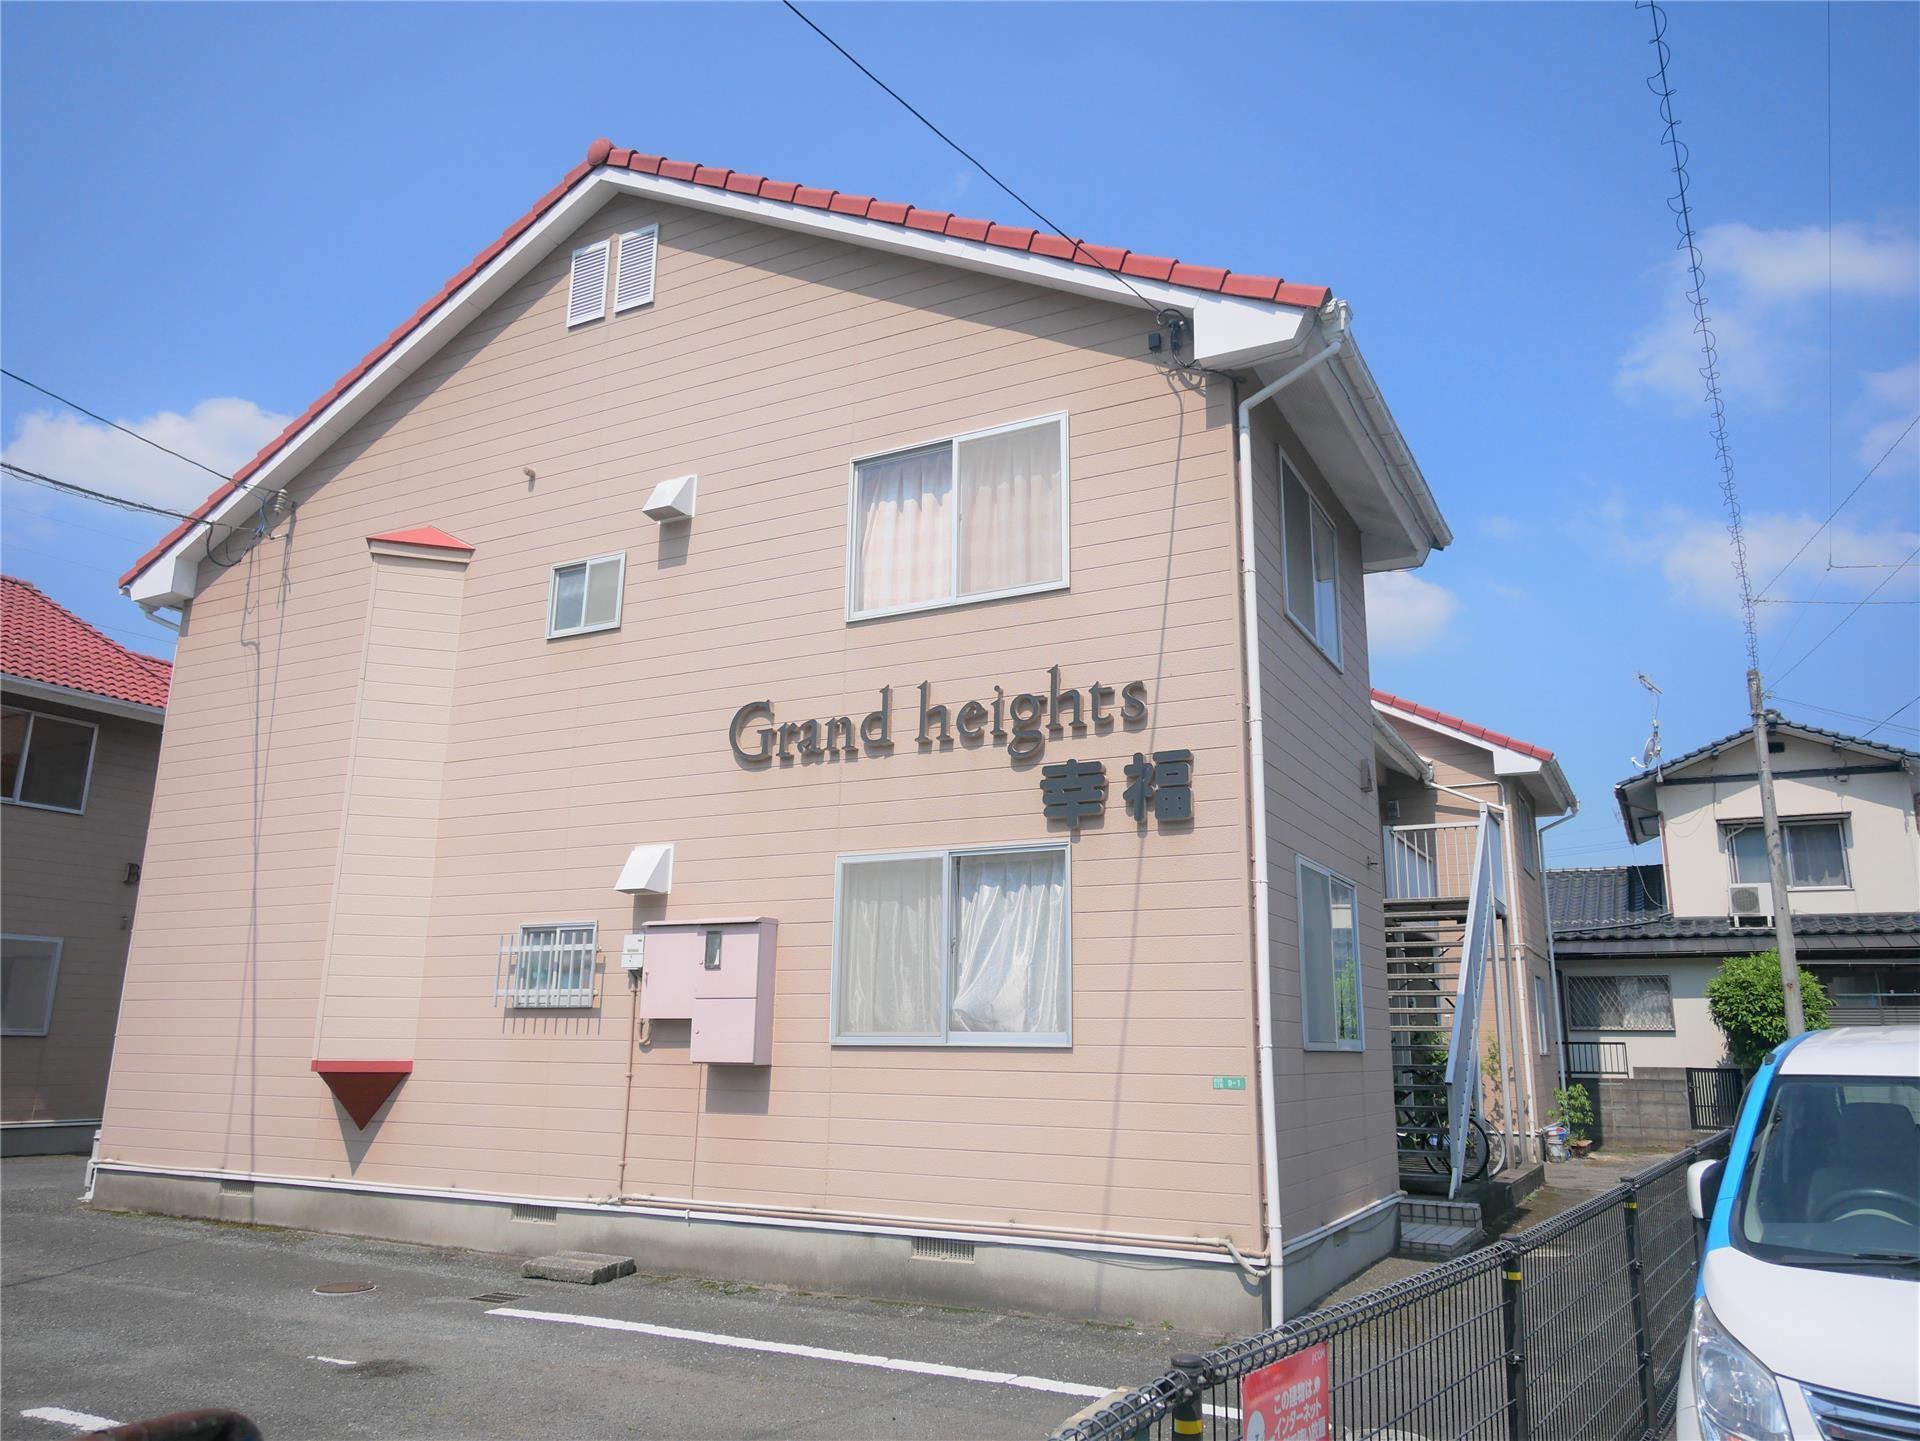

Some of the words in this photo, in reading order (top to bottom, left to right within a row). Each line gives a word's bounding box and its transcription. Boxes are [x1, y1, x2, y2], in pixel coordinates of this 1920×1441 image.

[729, 684, 893, 763] Grand
[914, 664, 1148, 760] heights
[1039, 748, 1193, 829] 幸福
